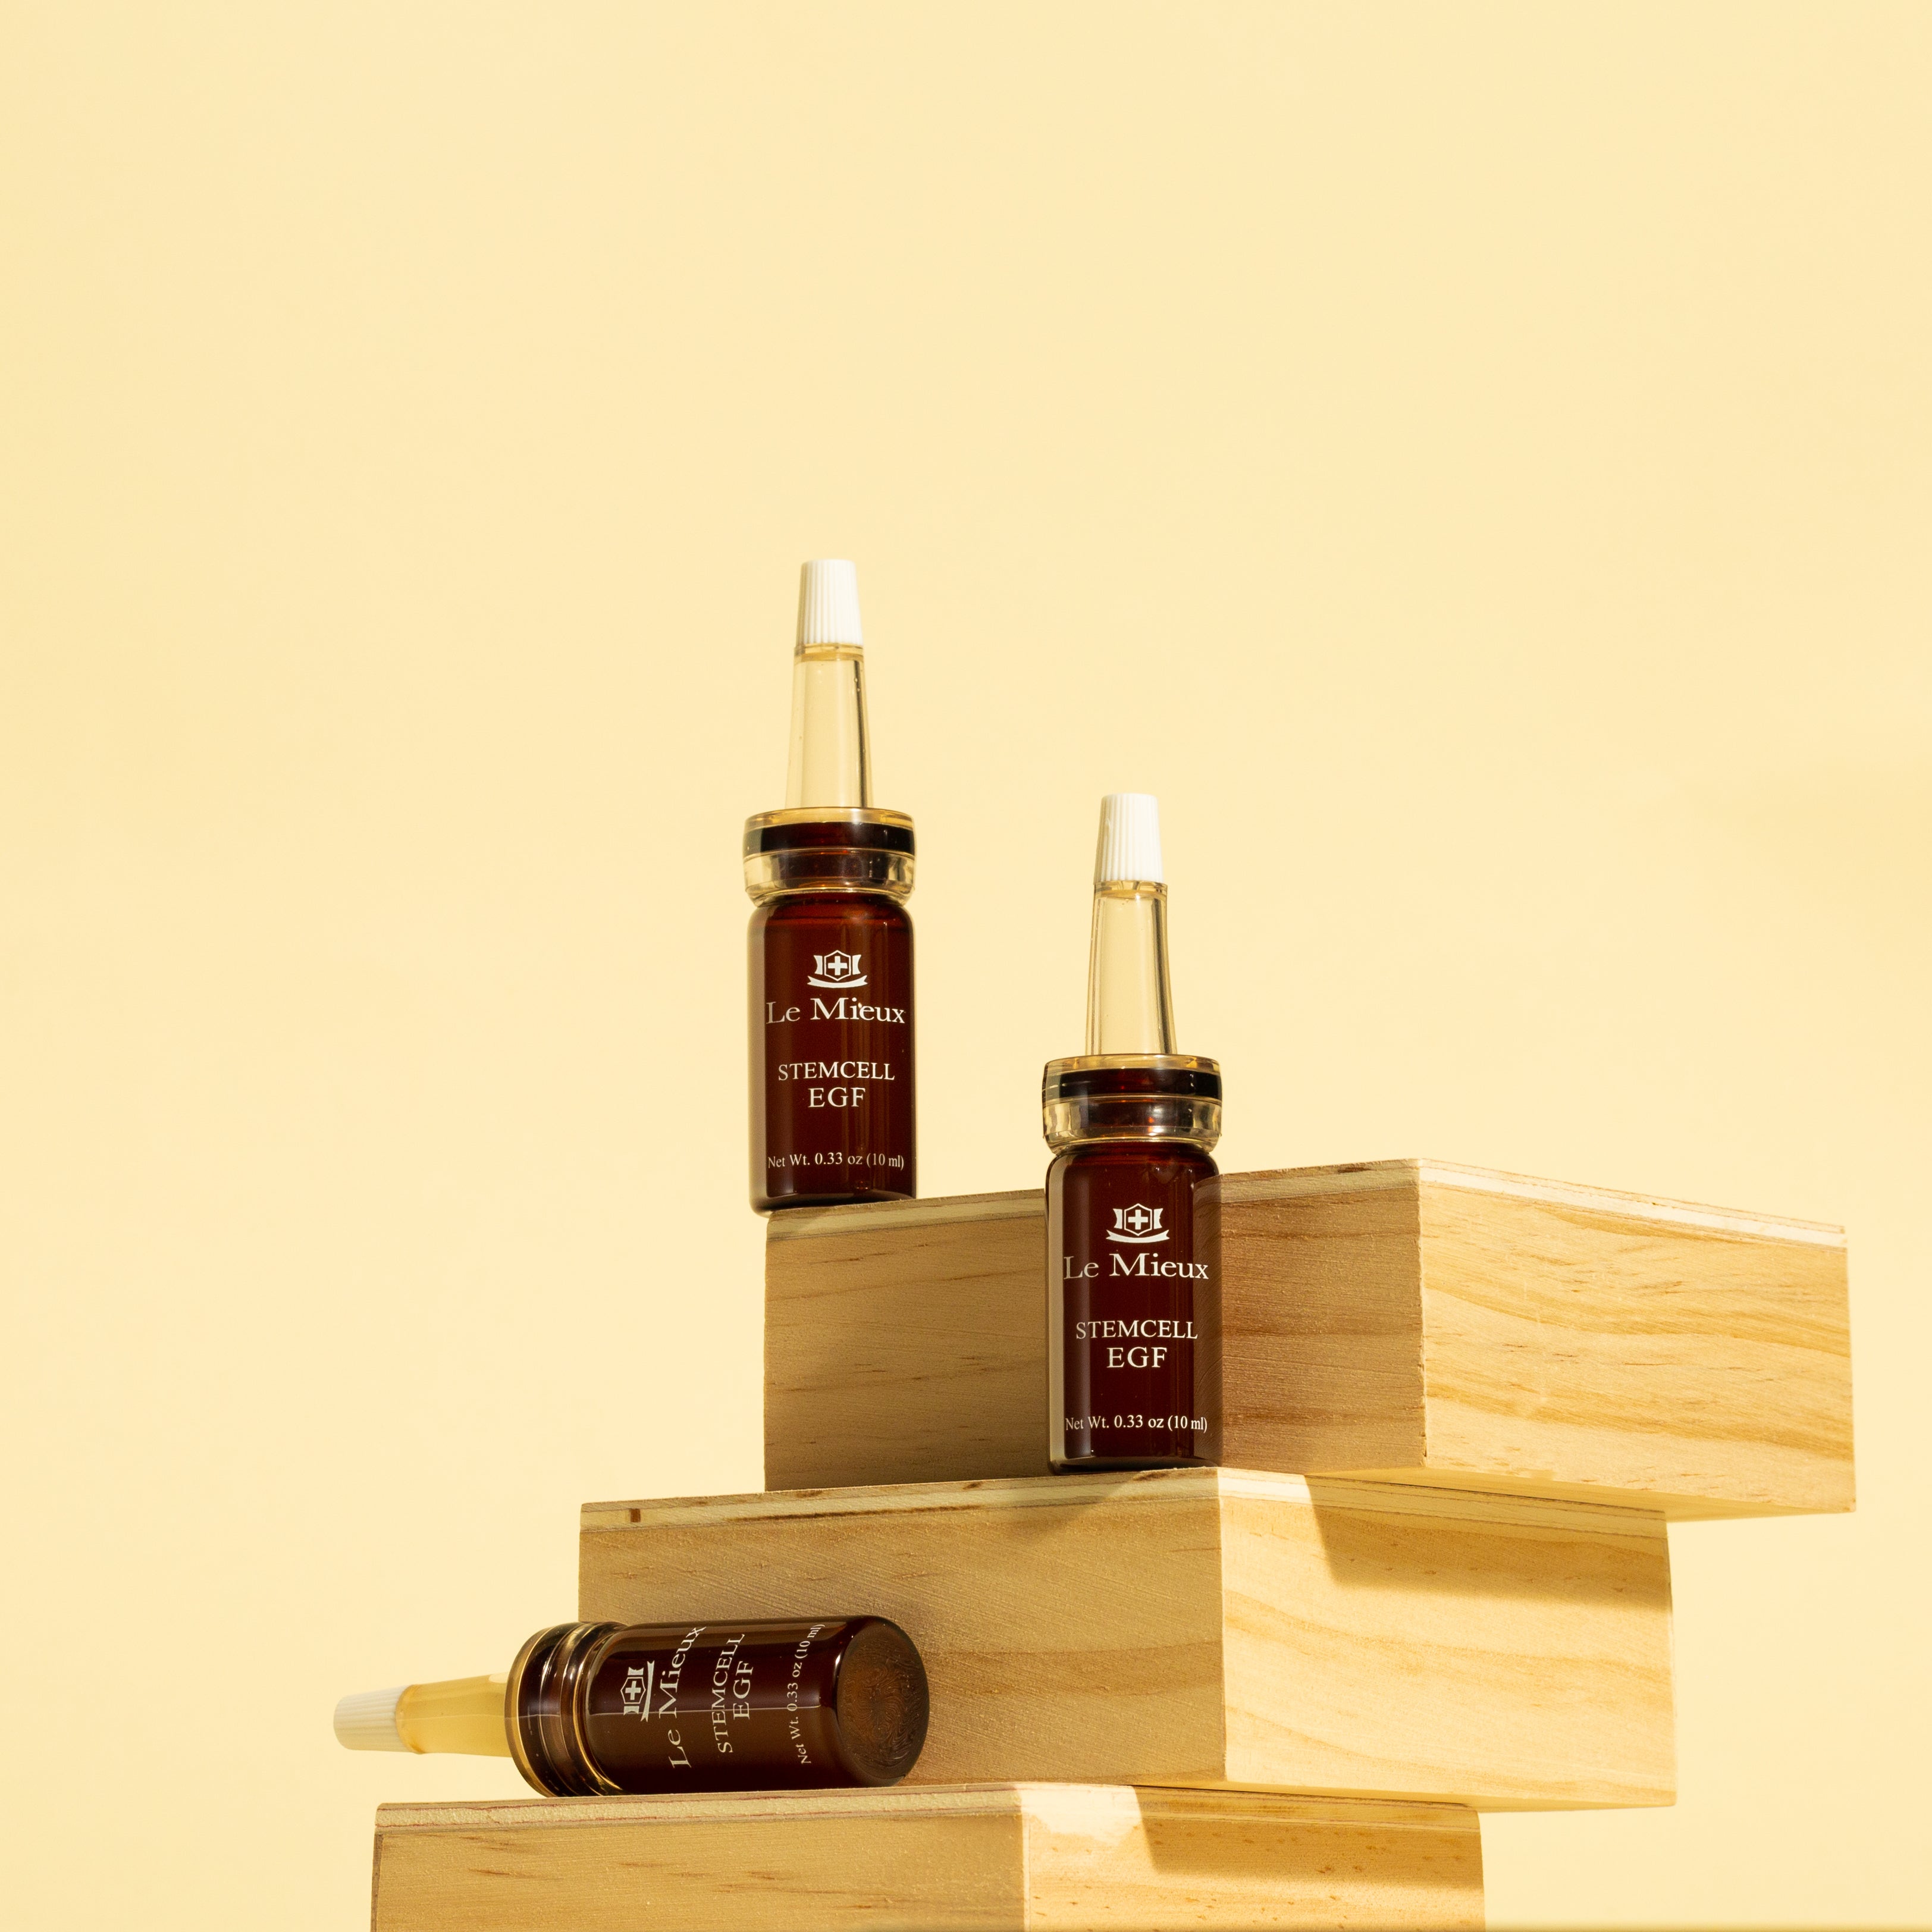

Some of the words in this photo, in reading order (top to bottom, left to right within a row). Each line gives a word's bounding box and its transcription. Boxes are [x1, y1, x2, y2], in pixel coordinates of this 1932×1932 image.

[766, 1002, 800, 1024] Le
[810, 997, 905, 1024] Mieux
[779, 1061, 895, 1081] STEMCELL
[808, 1087, 866, 1108] EGF
[768, 1155, 785, 1168] Net
[789, 1153, 810, 1166] Wt.
[815, 1152, 843, 1165] 0.33
[848, 1155, 862, 1165] oz
[867, 1153, 885, 1168] (10
[889, 1155, 904, 1171] ml)
[1064, 1256, 1099, 1279] Le
[1109, 1253, 1209, 1279] Mieux
[1076, 1319, 1198, 1340] STEMCELL
[1106, 1347, 1167, 1368] EGF
[1065, 1417, 1084, 1430] Net
[1087, 1415, 1109, 1428] Wt.
[1114, 1414, 1143, 1428] 0.33
[1148, 1417, 1164, 1428] oz
[1168, 1415, 1187, 1431] (10
[1191, 1416, 1208, 1433] ml)
[807, 1624, 826, 1639] ml)
[795, 1639, 811, 1660] (10
[659, 1626, 707, 1719] Mieux
[792, 1662, 803, 1678] oz
[711, 1633, 745, 1753] STEMCELL
[733, 1660, 754, 1720] EGF
[787, 1682, 799, 1712] 0.33
[789, 1717, 801, 1741] Wt.
[667, 1729, 692, 1769] Le
[795, 1743, 812, 1765] Net
